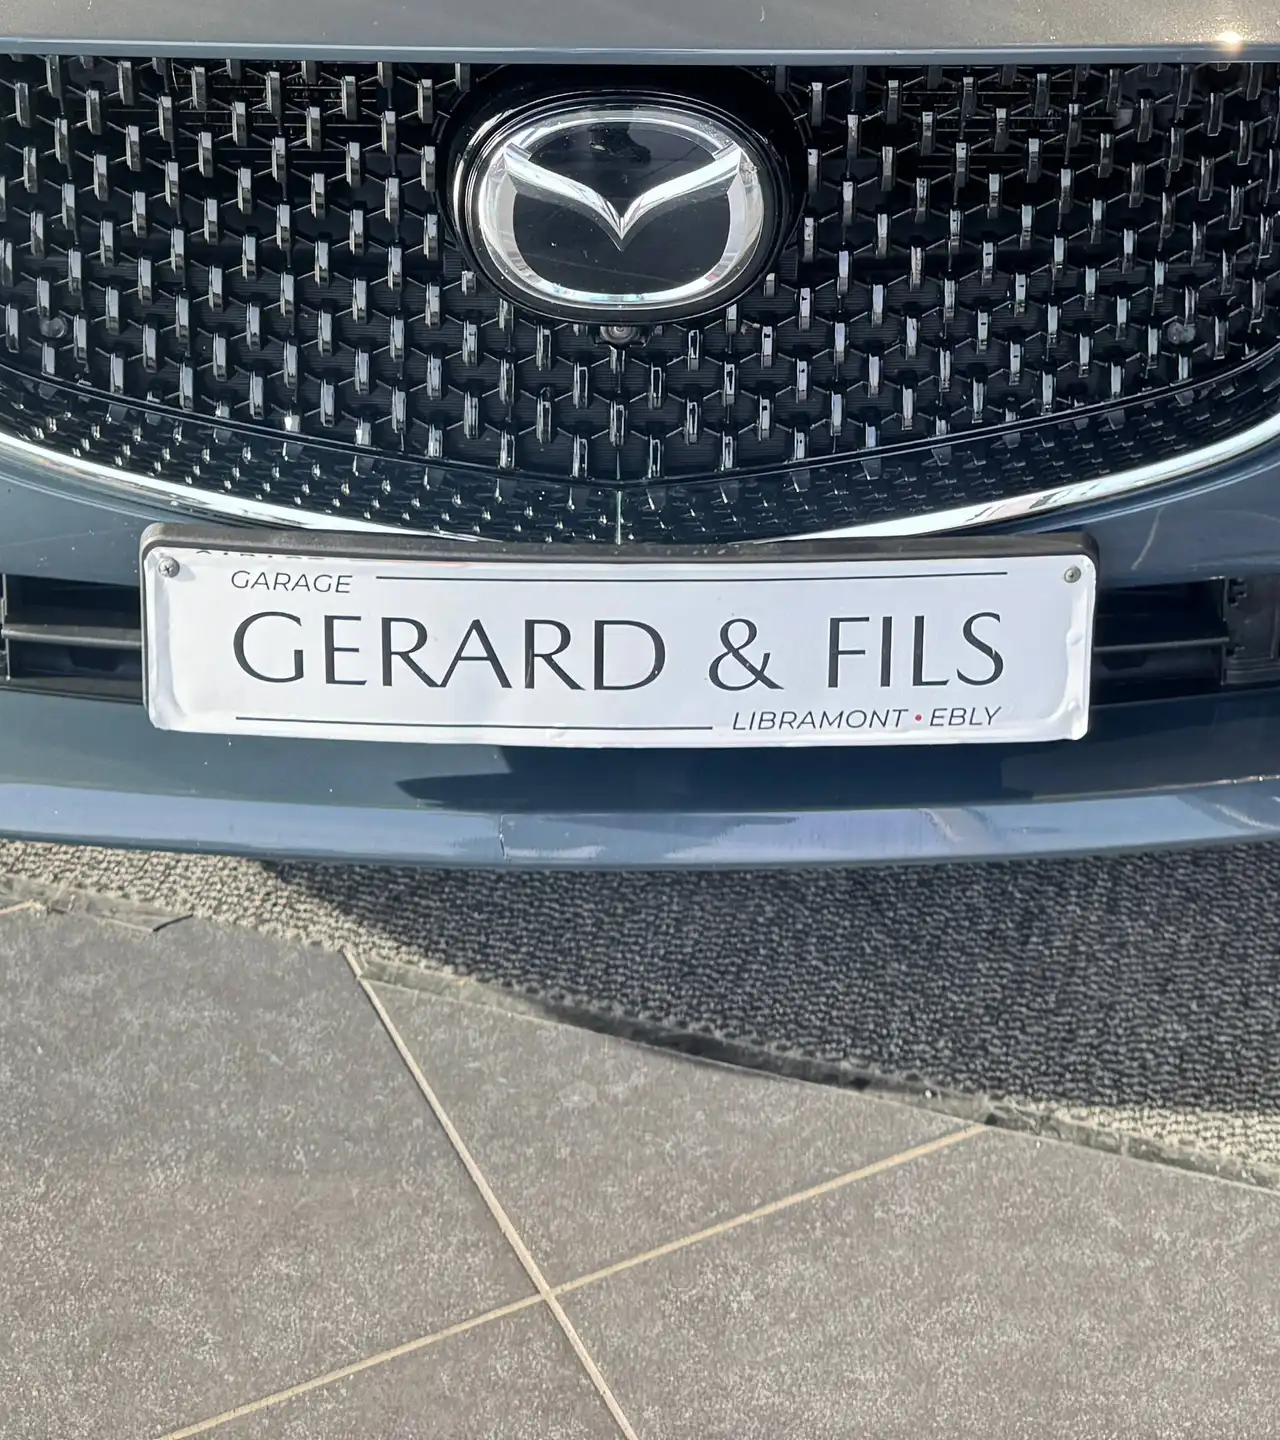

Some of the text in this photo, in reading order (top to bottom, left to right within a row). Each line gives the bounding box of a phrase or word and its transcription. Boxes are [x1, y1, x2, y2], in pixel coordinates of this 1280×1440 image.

[230, 569, 354, 594] GARAGE
[232, 610, 1005, 692] GERARD & FILS
